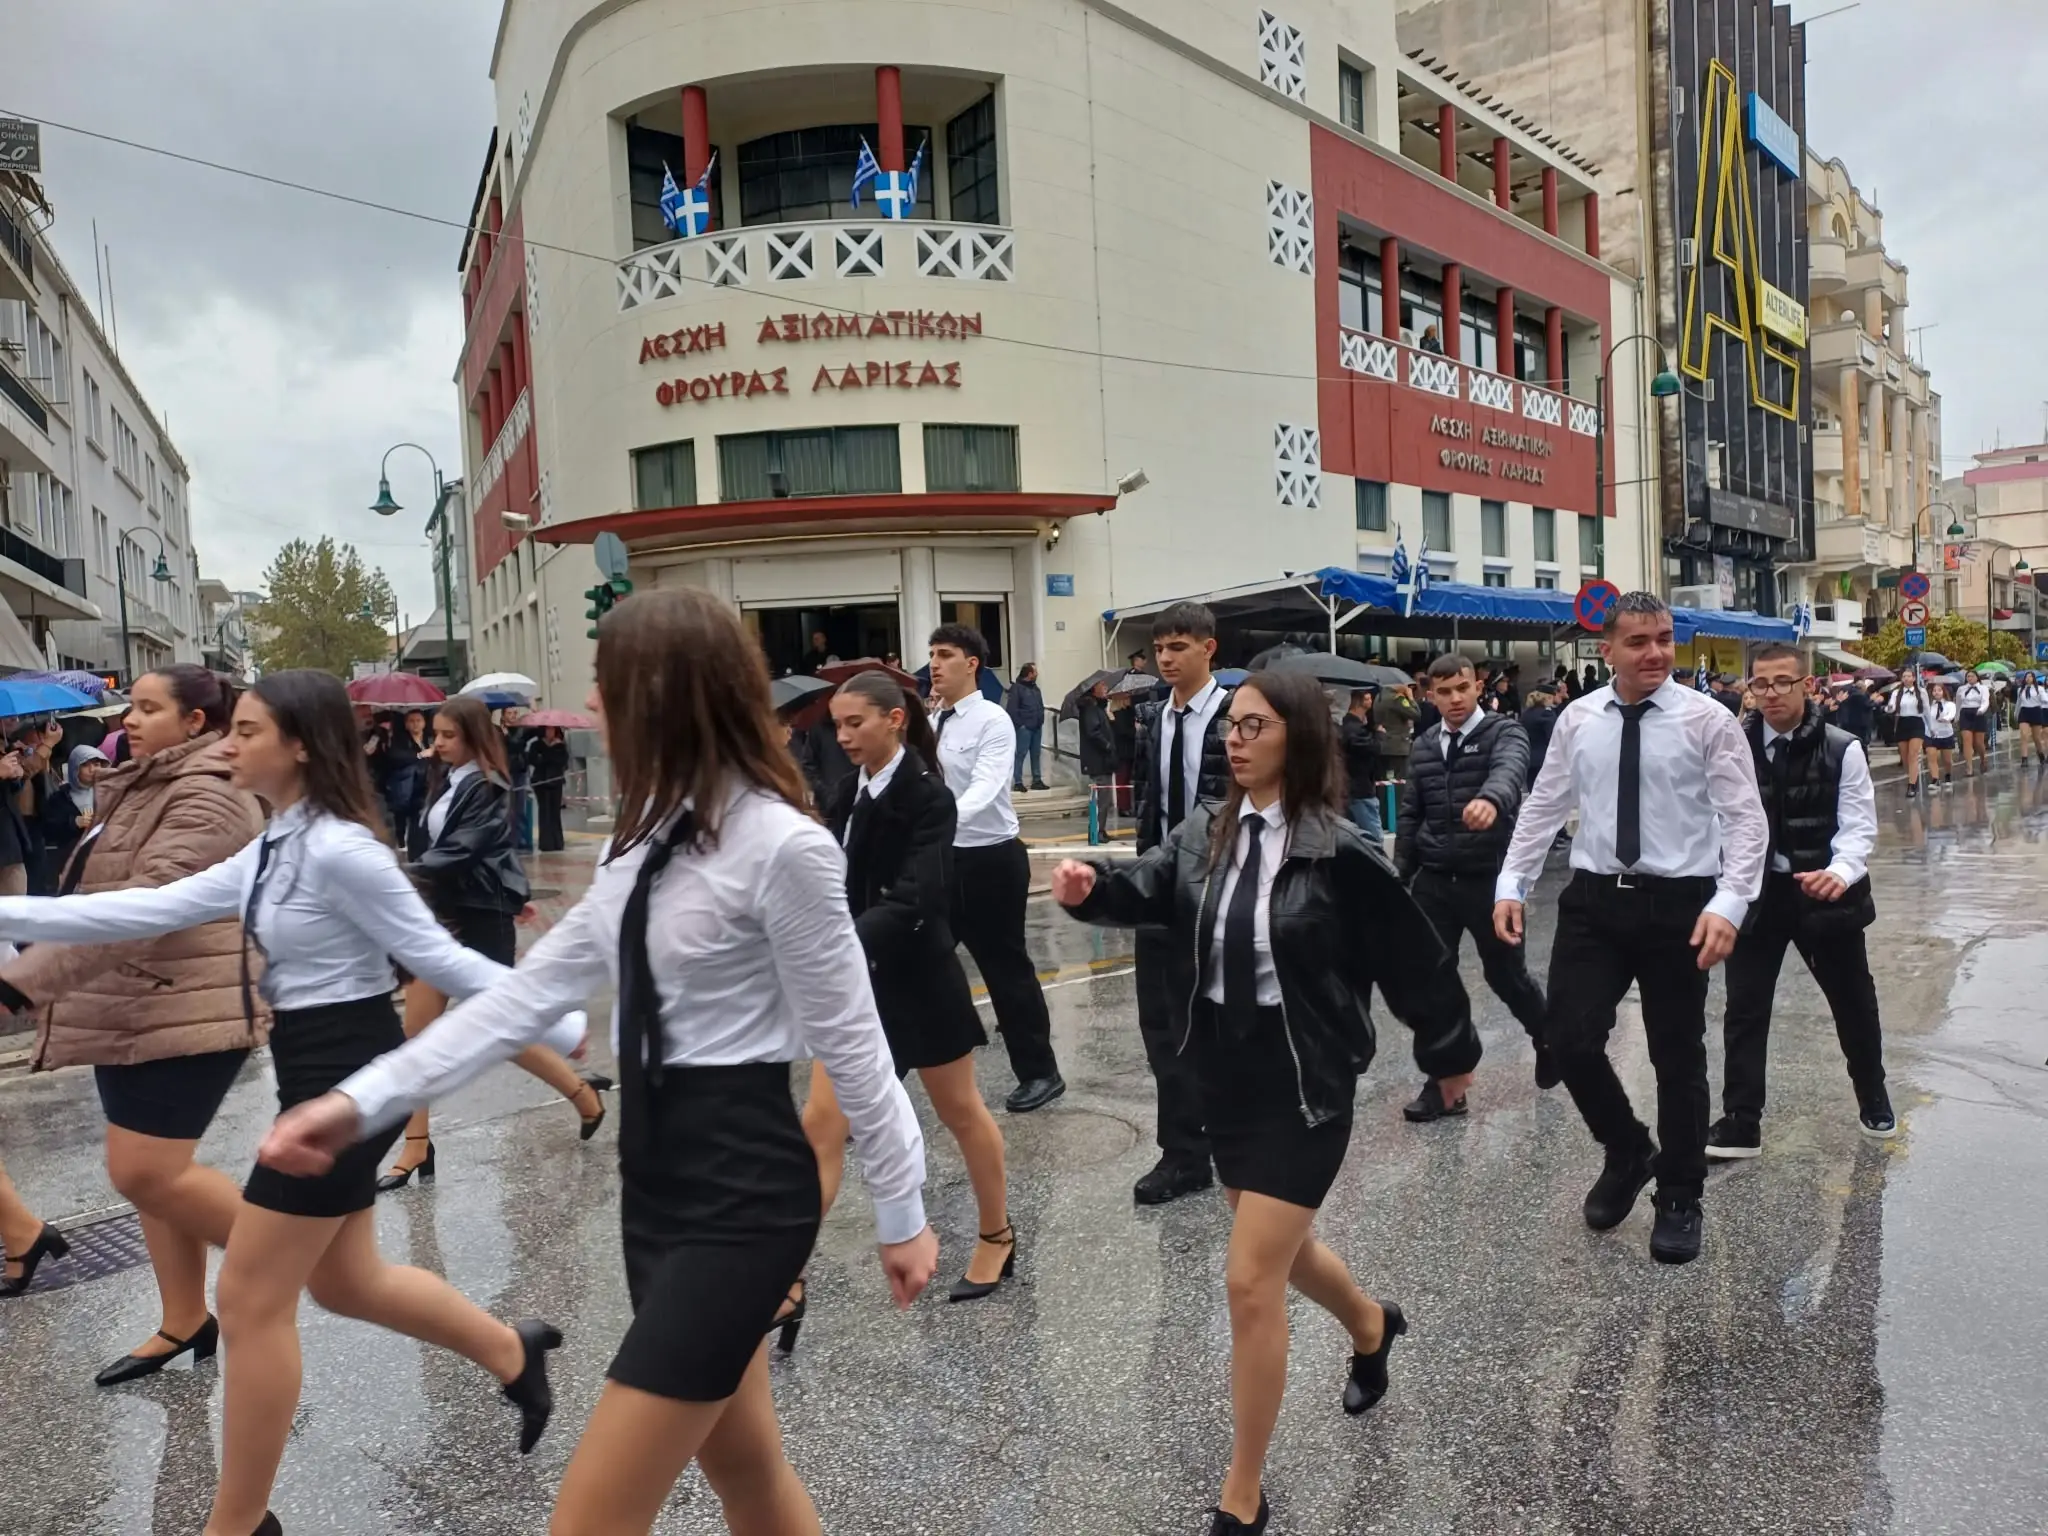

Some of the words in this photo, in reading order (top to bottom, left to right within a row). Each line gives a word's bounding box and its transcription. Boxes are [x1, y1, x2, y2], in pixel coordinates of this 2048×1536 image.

[1765, 290, 1802, 328] ALTERLIFE
[639, 321, 727, 364] ΛΕΣΧΗ
[757, 309, 983, 344] ΑΞΙΩΜΑΤΙΚΩΝ
[656, 366, 790, 407] ΦΡΟΥΡΑΣ
[812, 360, 962, 392] ΛΑΡΙΣΑΣ
[1430, 413, 1473, 440] ΛΕΣΧΗ
[1440, 449, 1494, 476] ΦΡΟΥΡΑΣ
[1501, 460, 1546, 486] ΛΑΡΙΣΑΣ
